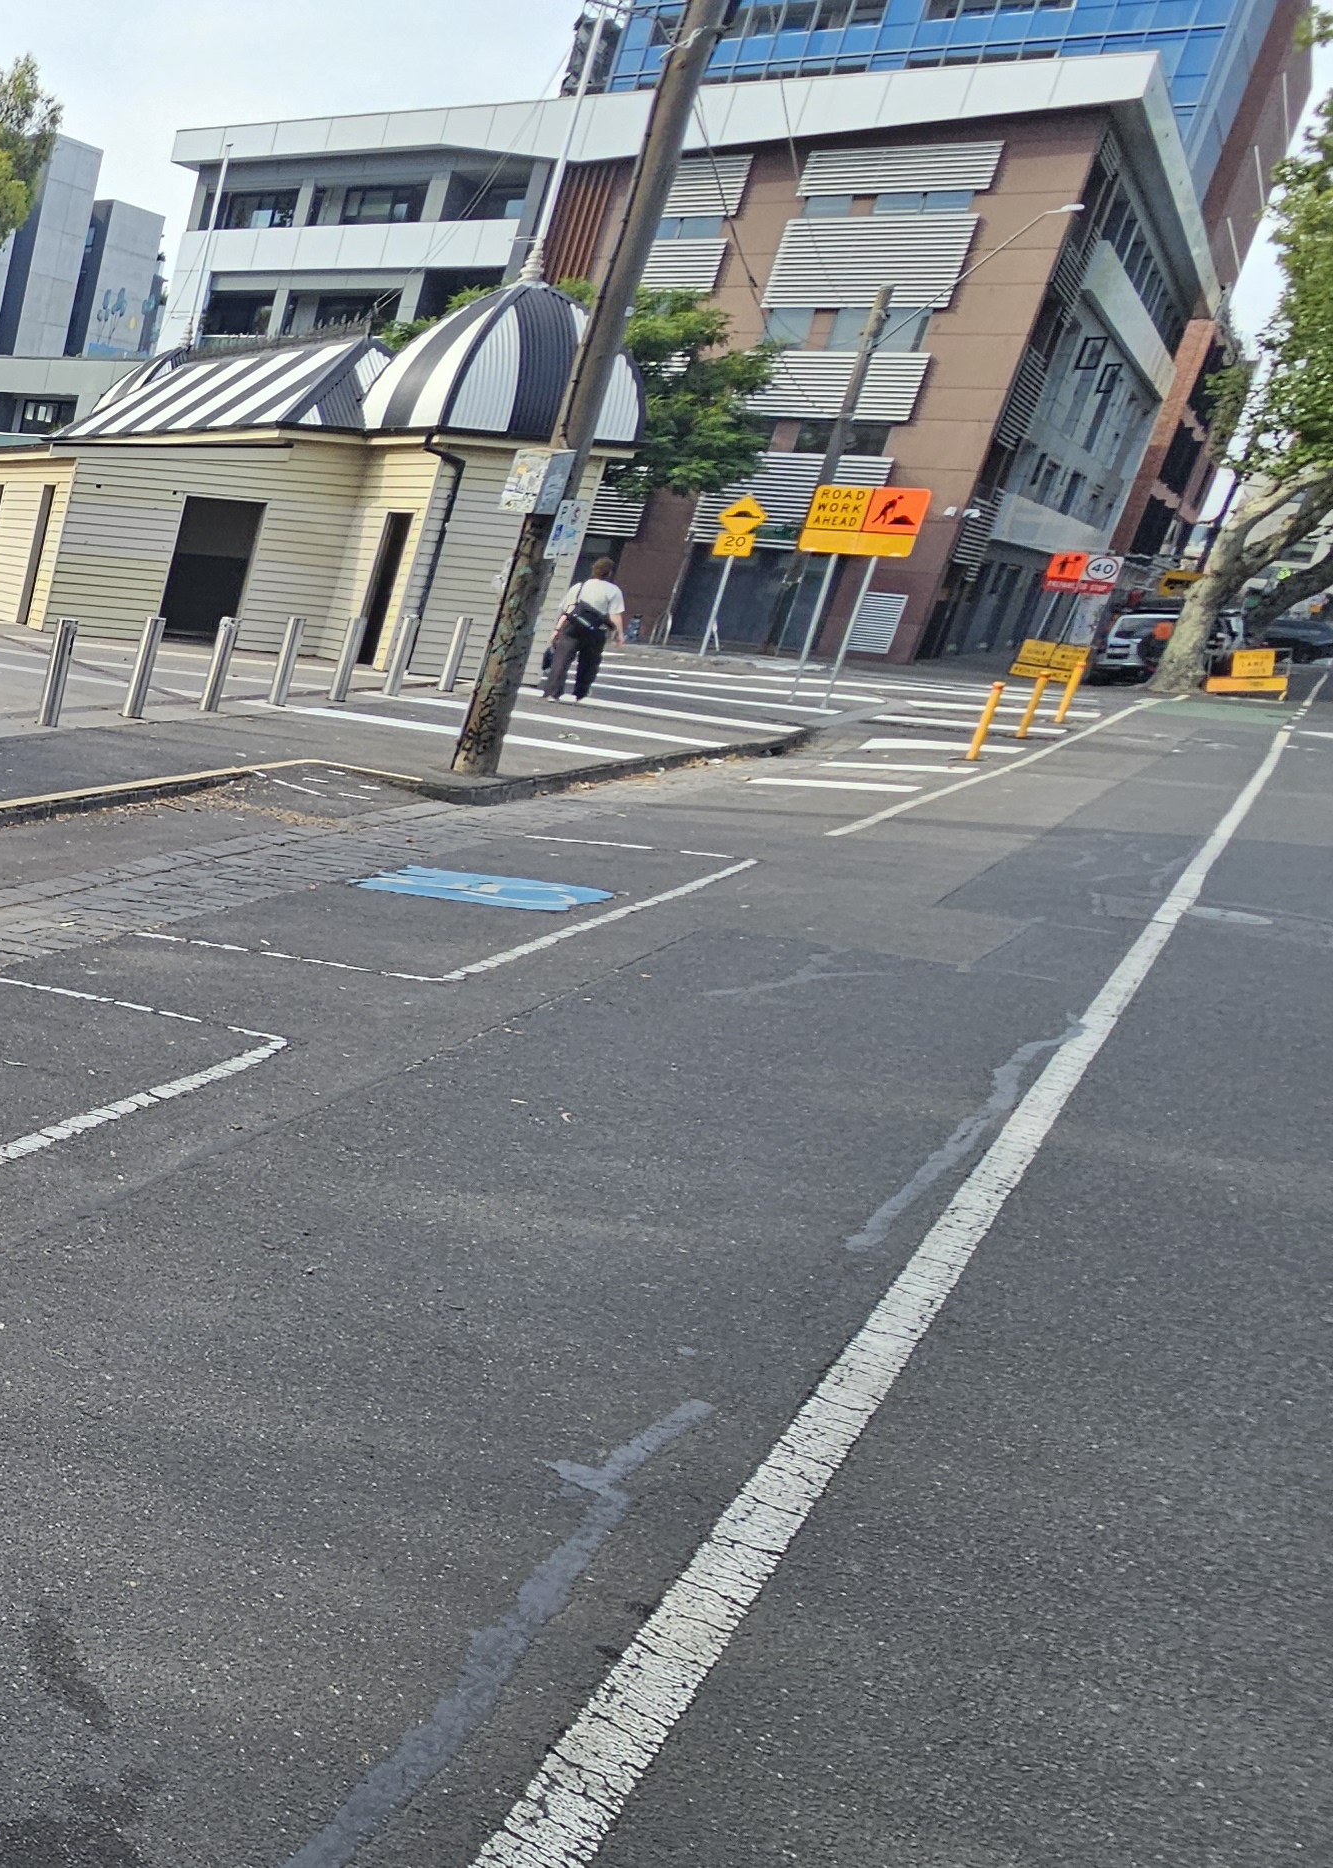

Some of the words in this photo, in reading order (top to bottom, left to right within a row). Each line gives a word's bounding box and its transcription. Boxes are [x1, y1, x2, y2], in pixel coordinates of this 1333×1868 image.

[820, 488, 866, 501] ROAD
[817, 502, 863, 514] WORK
[813, 515, 858, 527] AHEAD
[724, 536, 746, 547] 20
[1091, 563, 1114, 575] 40
